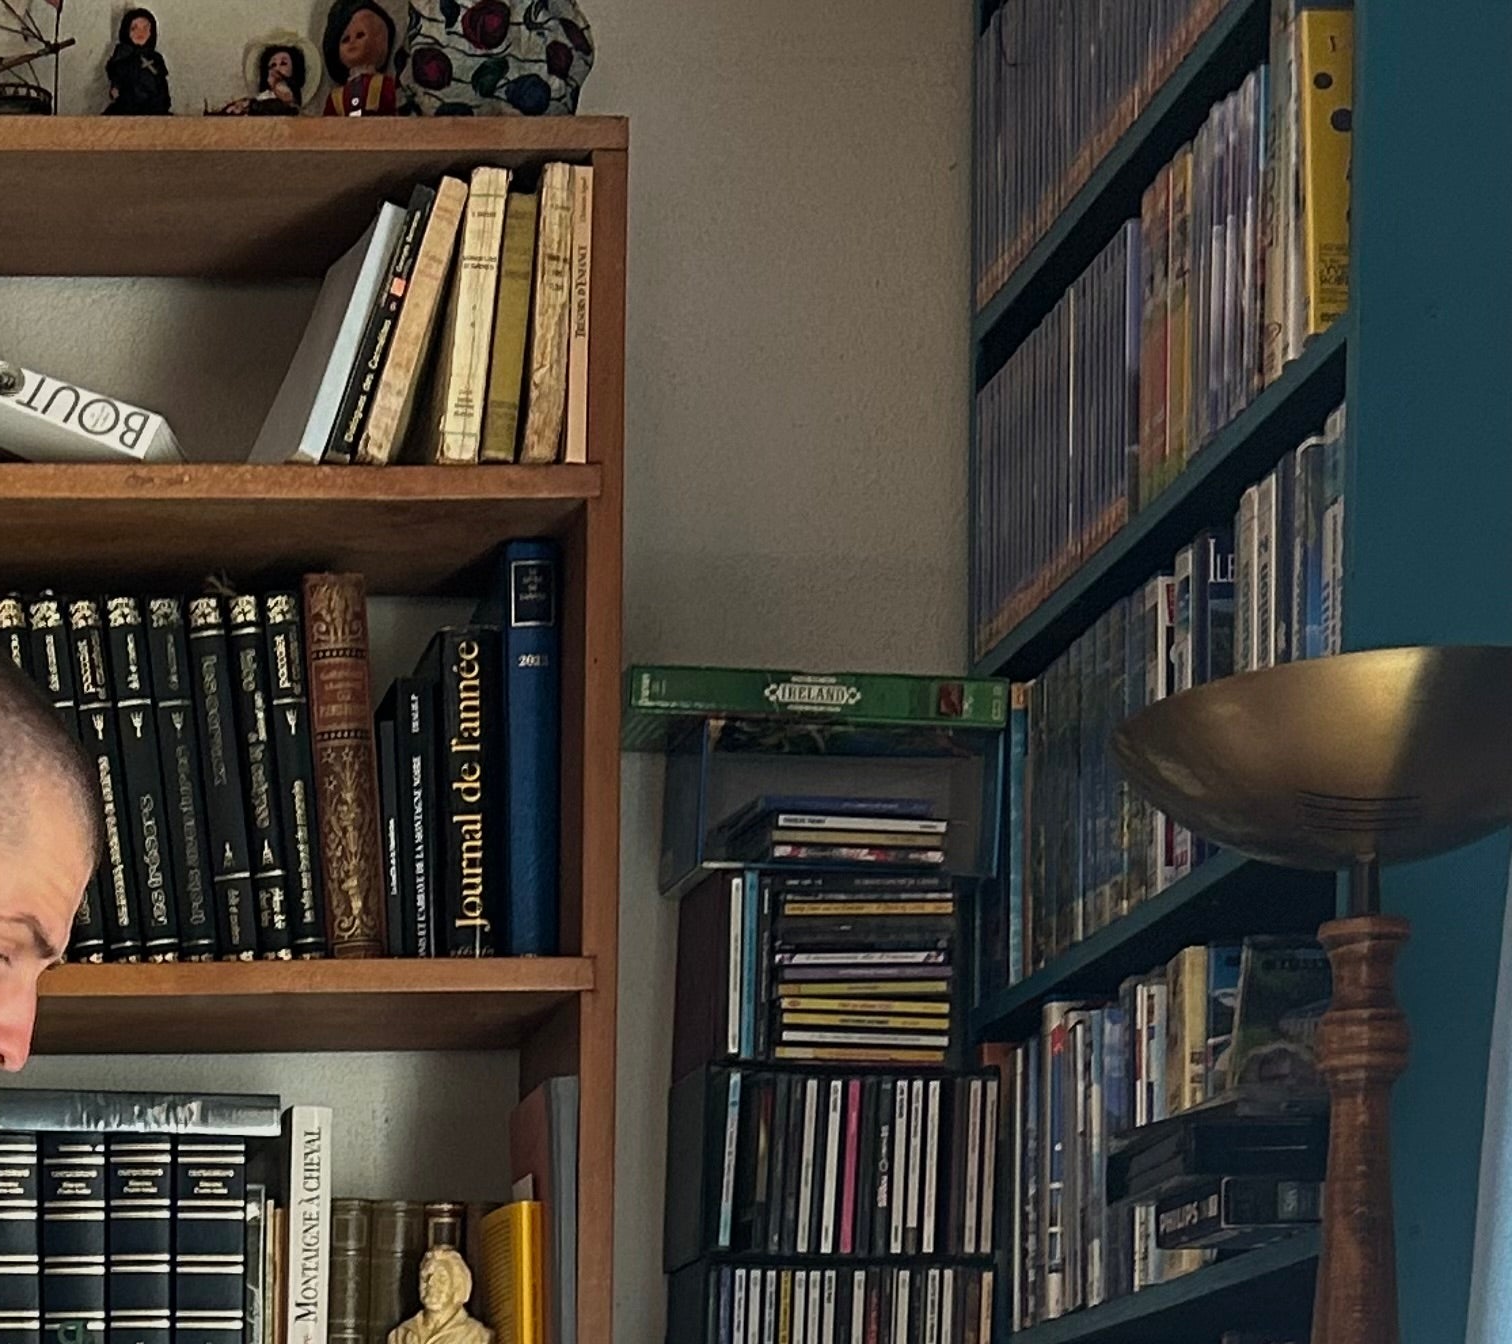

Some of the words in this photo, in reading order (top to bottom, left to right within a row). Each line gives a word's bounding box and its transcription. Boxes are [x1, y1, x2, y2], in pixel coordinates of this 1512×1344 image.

[451, 640, 481, 753] l'année
[781, 685, 848, 702] IRELAND
[452, 762, 481, 803] de
[455, 813, 489, 932] Journal
[304, 1125, 322, 1192] CHEVAL
[303, 1193, 321, 1210] À
[294, 1211, 321, 1324] MONTAIGNE
